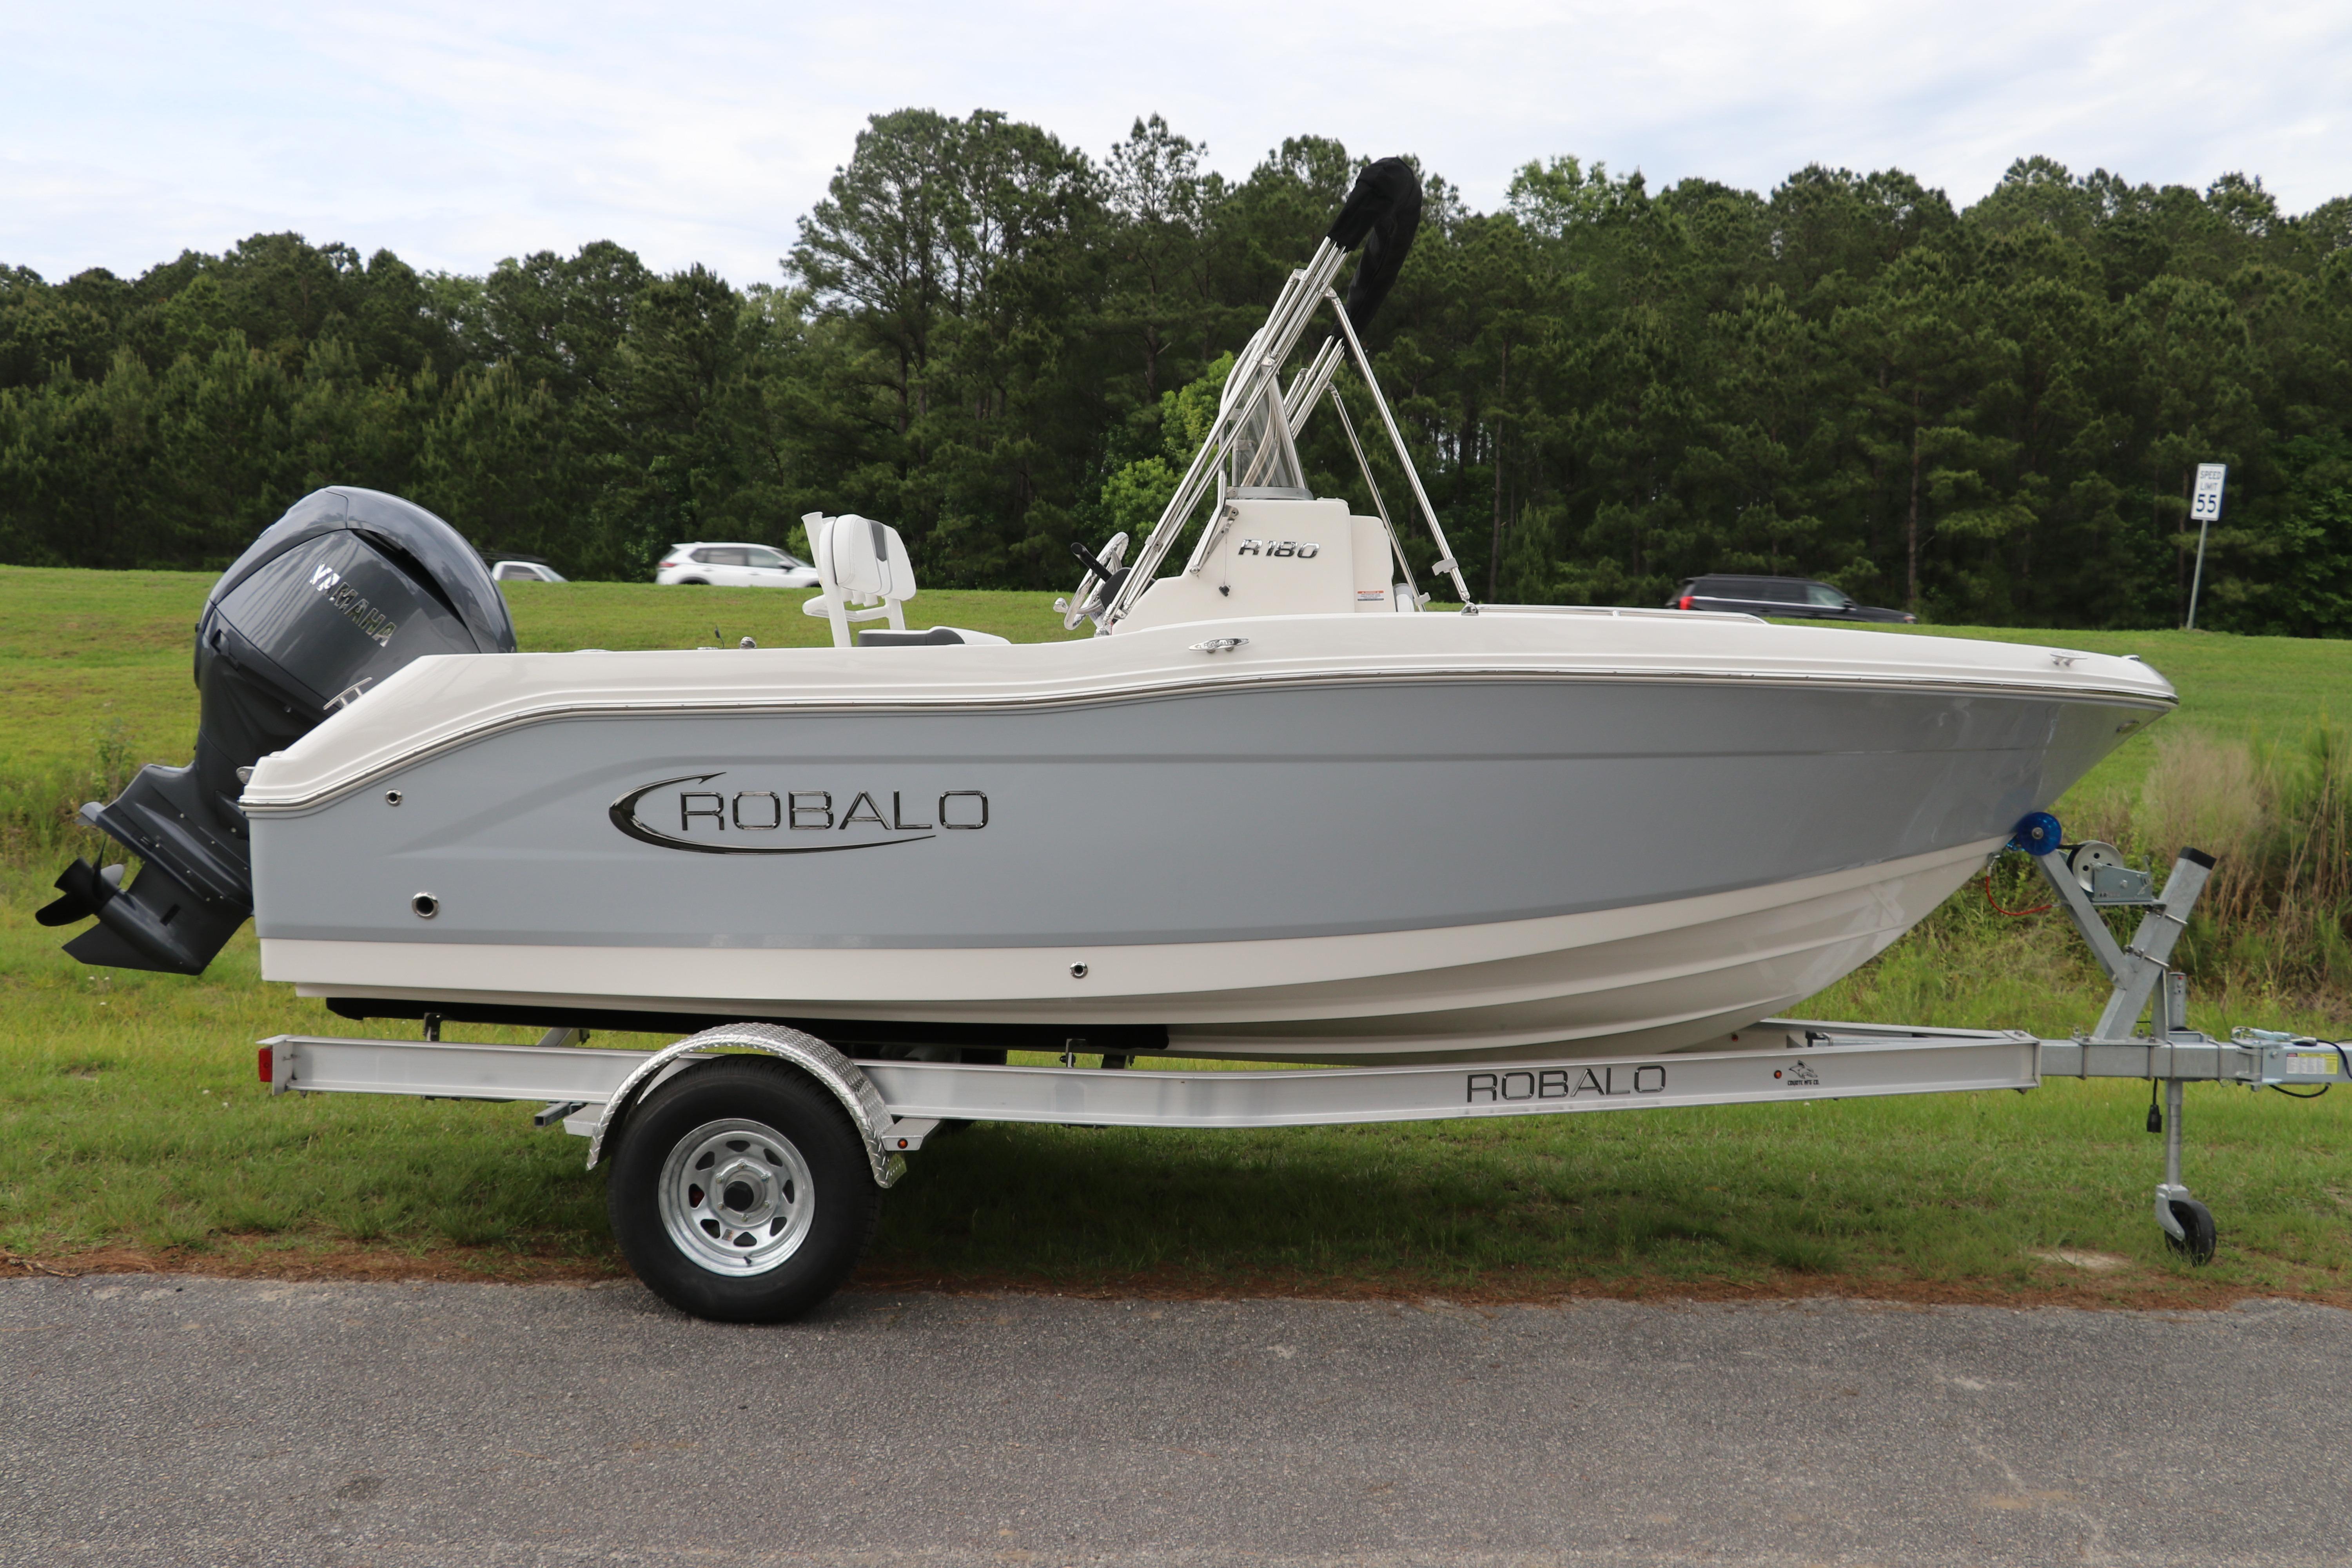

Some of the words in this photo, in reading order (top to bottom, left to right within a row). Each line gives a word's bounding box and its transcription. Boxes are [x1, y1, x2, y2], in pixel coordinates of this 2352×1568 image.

[2200, 471, 2221, 479] SPEED
[2196, 494, 2217, 513] 55
[1238, 539, 1320, 558] R180
[309, 563, 396, 647] YAMAHA
[680, 790, 989, 831] ROBALO
[1467, 1065, 1666, 1103] ROBALO
